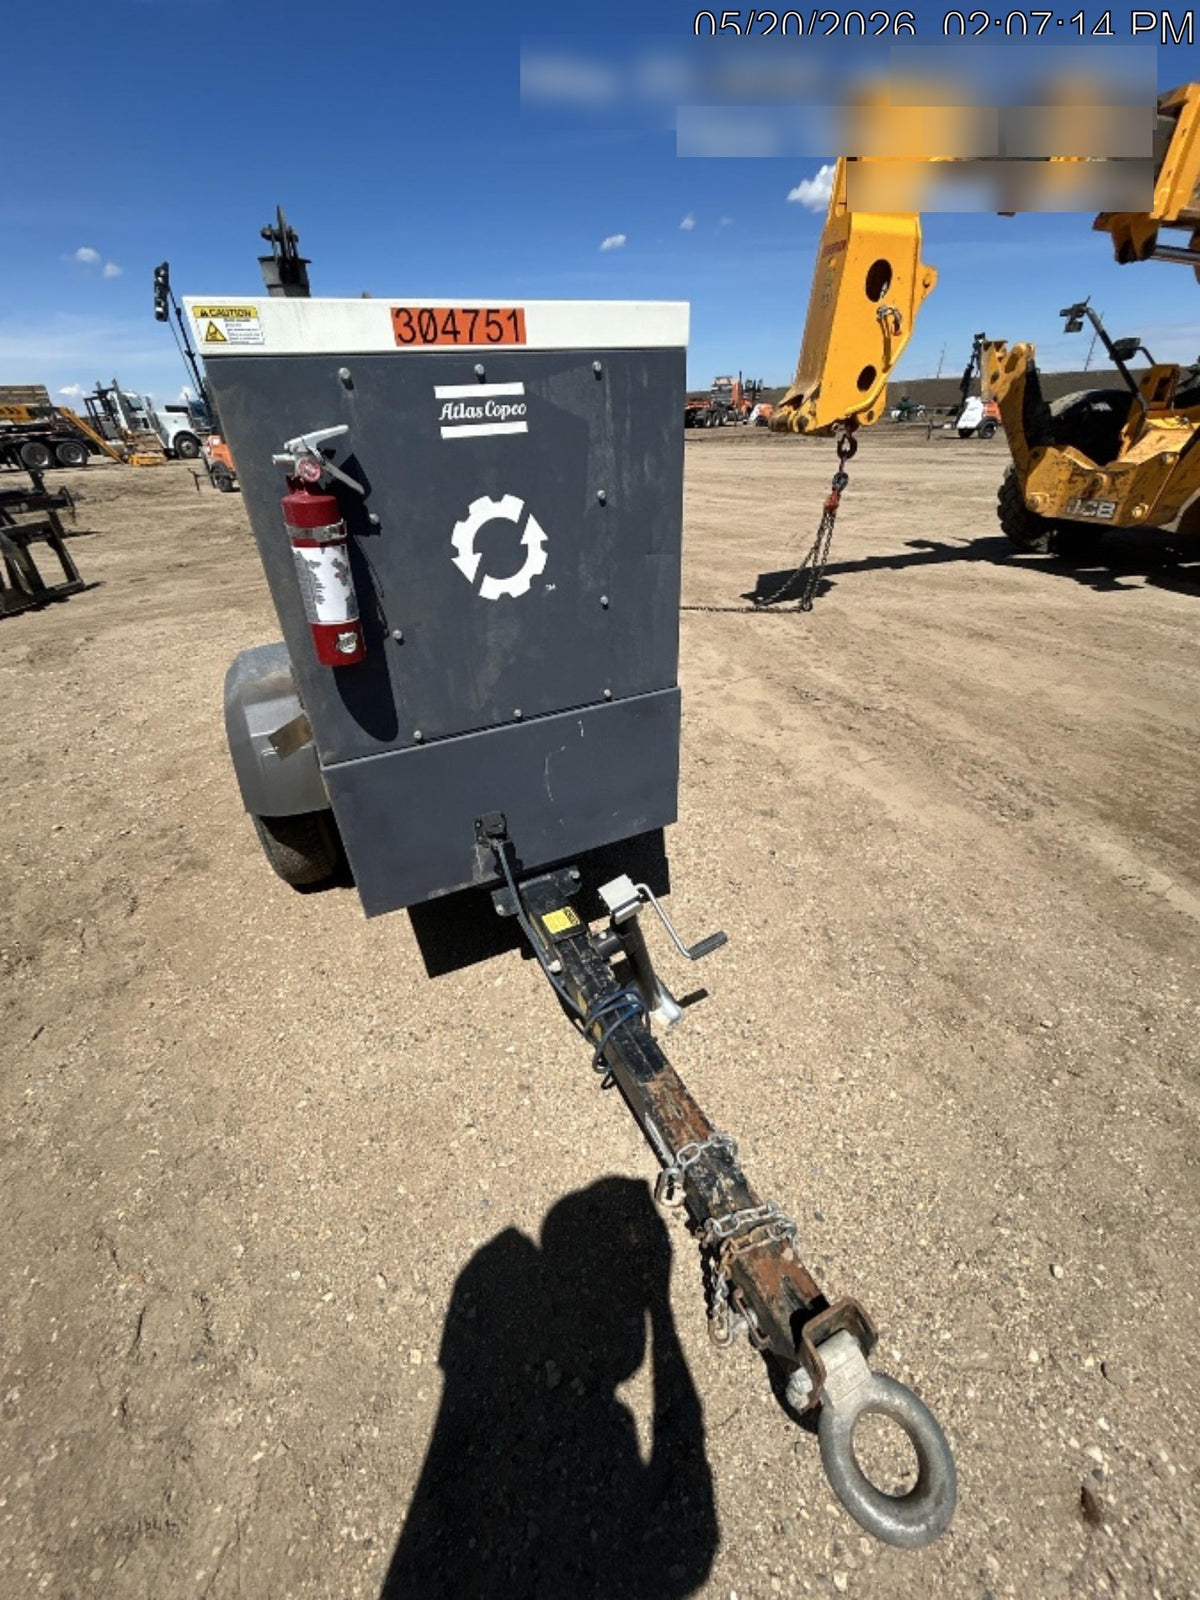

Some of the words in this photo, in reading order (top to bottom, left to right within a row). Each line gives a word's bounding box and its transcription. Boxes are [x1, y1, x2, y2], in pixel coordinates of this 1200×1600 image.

[209, 308, 252, 318] CAUTION
[394, 307, 519, 344] 304751
[439, 401, 483, 420] Atlas
[484, 399, 527, 420] Copco
